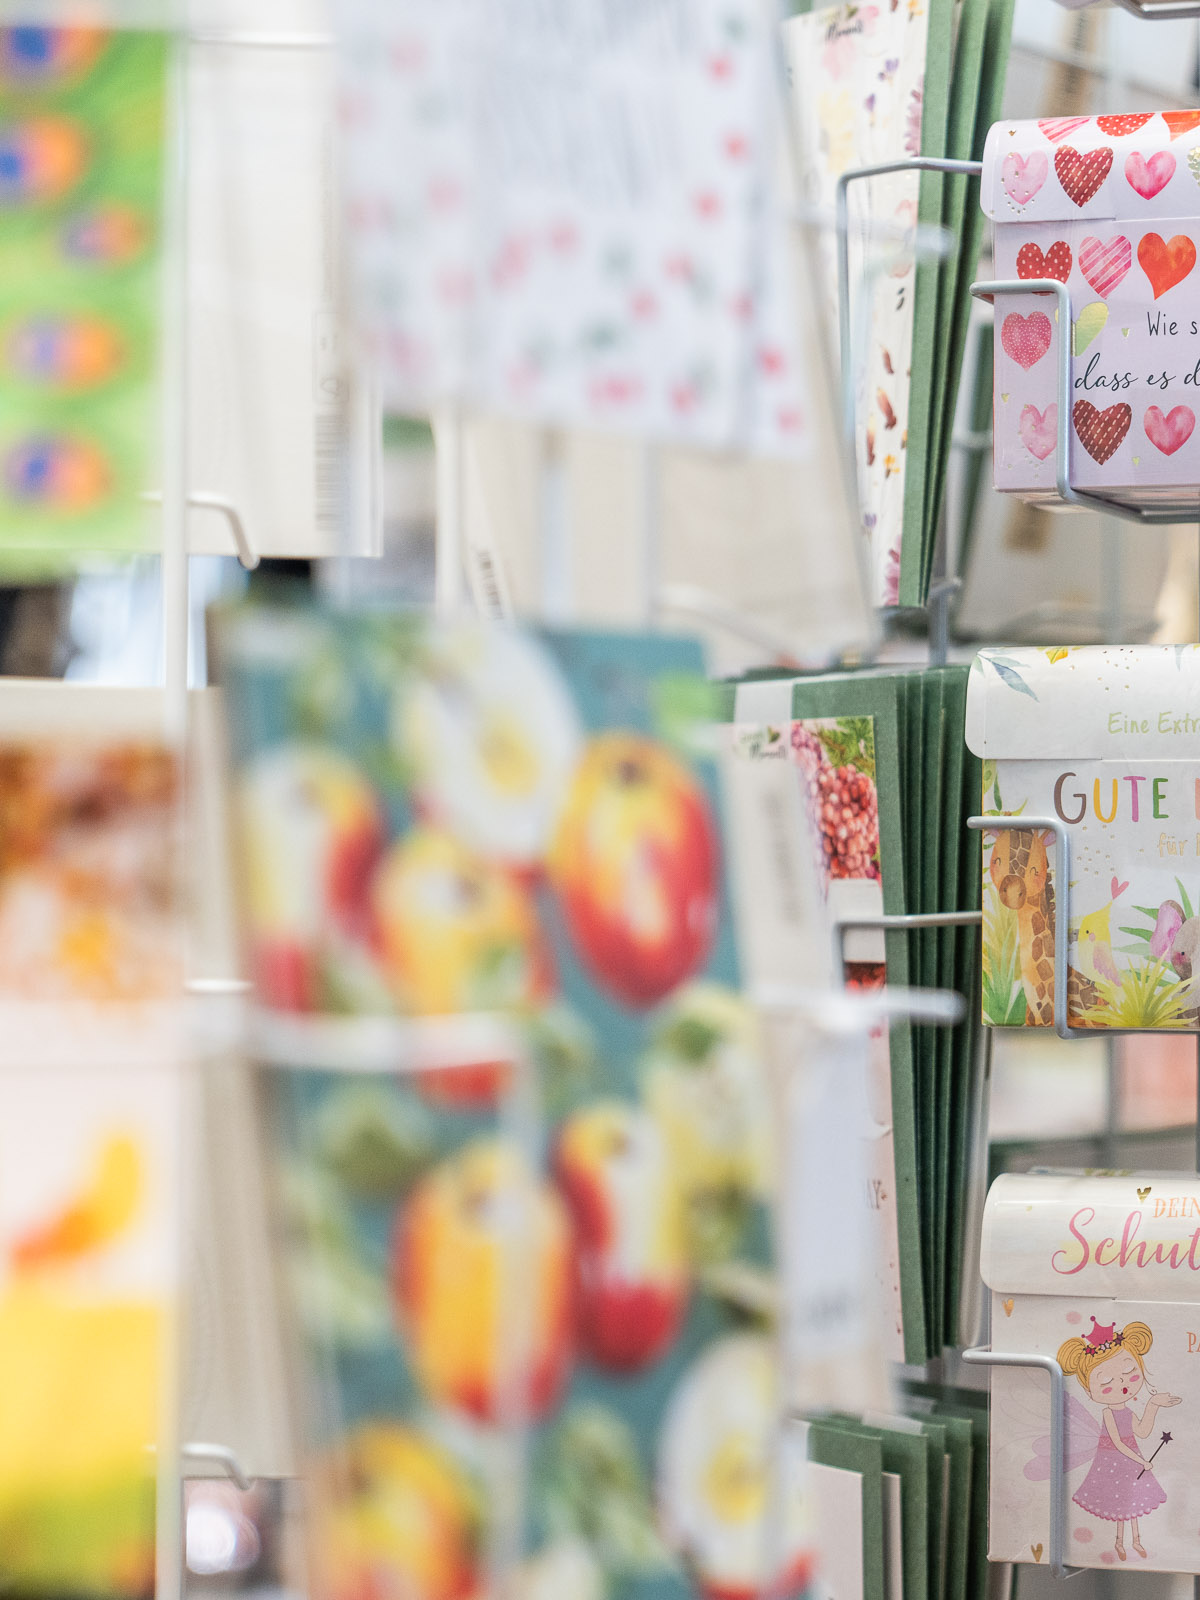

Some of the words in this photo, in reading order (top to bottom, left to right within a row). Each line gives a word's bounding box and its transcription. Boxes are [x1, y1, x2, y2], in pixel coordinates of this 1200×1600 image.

[1147, 310, 1179, 337] Wie
[1074, 352, 1138, 391] dass
[1146, 371, 1176, 390] es
[1107, 711, 1150, 735] Eine
[1053, 771, 1170, 825] GUTE
[1157, 832, 1188, 856] für
